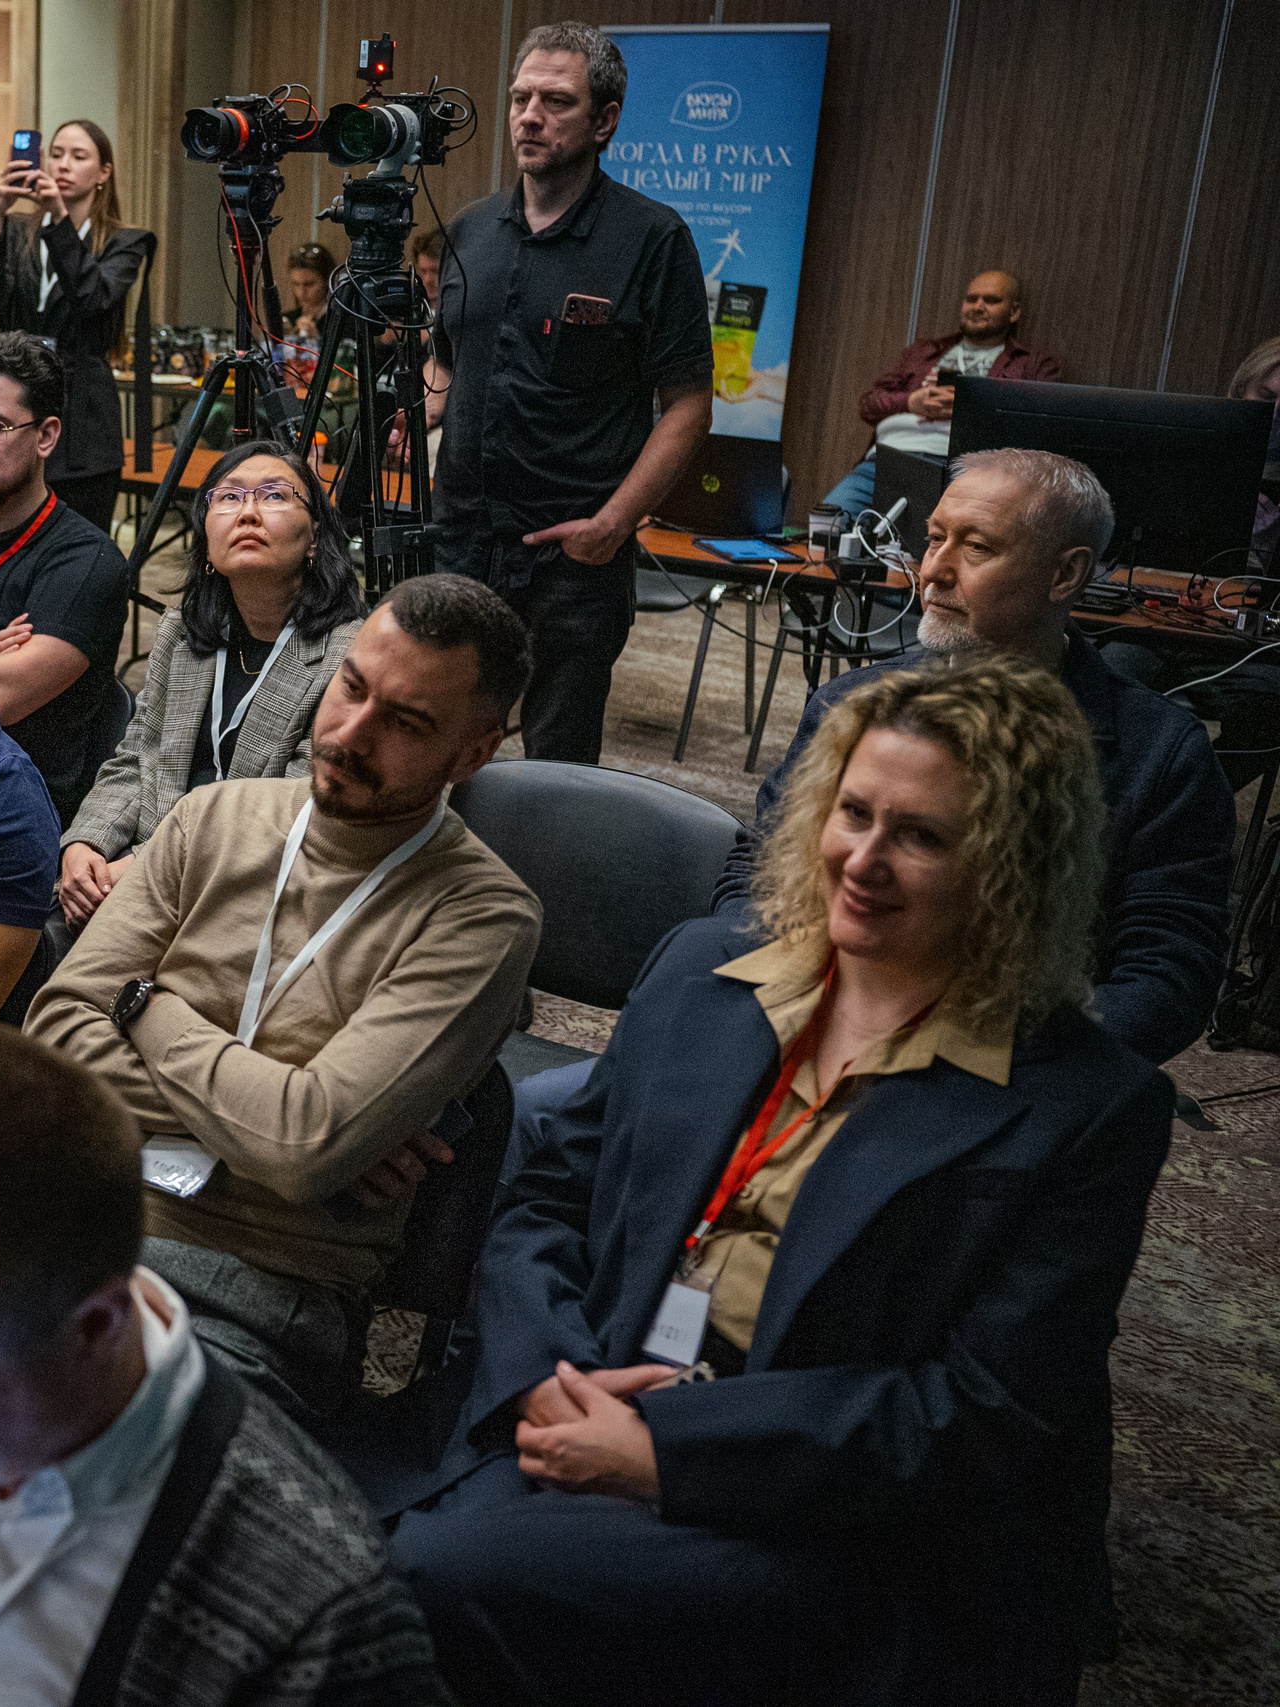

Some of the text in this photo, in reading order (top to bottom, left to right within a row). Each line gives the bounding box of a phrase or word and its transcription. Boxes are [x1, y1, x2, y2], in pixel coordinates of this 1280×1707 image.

[692, 143, 707, 164] В
[715, 143, 792, 167] РУКАХ
[720, 171, 772, 193] МИР
